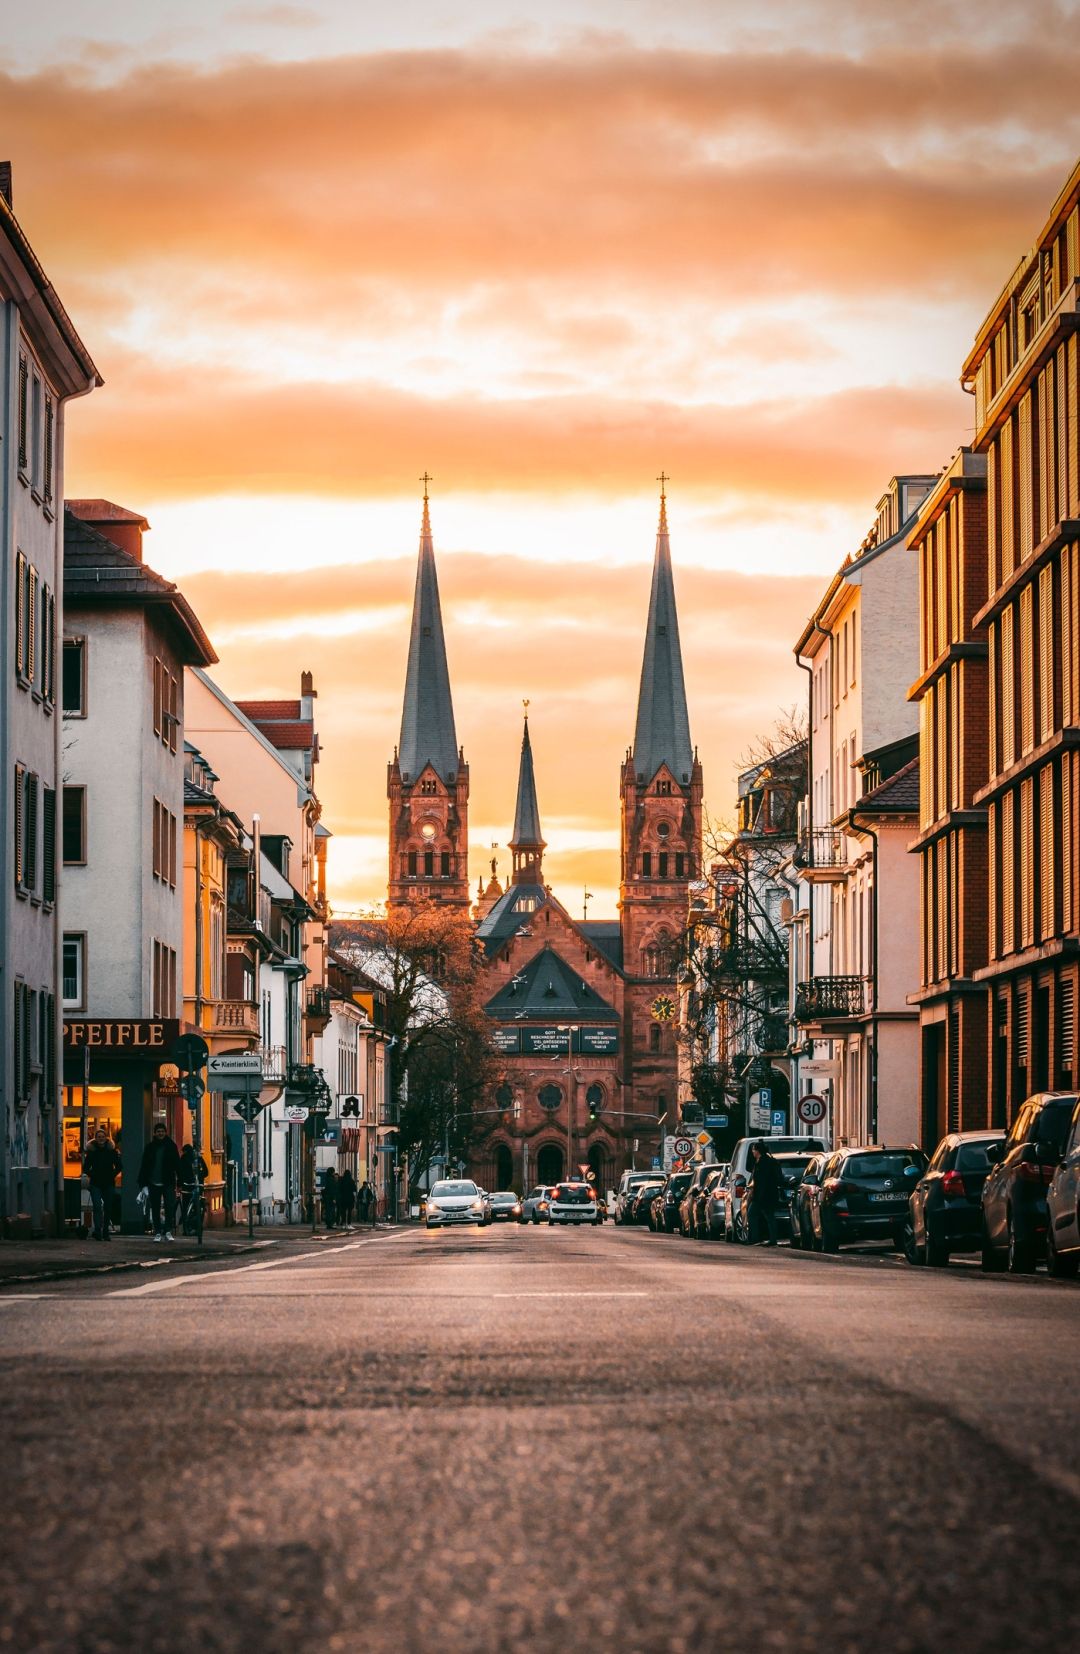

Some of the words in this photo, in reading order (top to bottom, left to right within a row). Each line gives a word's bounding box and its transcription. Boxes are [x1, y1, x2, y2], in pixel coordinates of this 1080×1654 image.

[221, 1060, 259, 1068] Kleintierklinik
[762, 1091, 768, 1105] P
[803, 1103, 820, 1116] 30
[774, 1112, 781, 1124] P
[678, 1143, 689, 1152] 30
